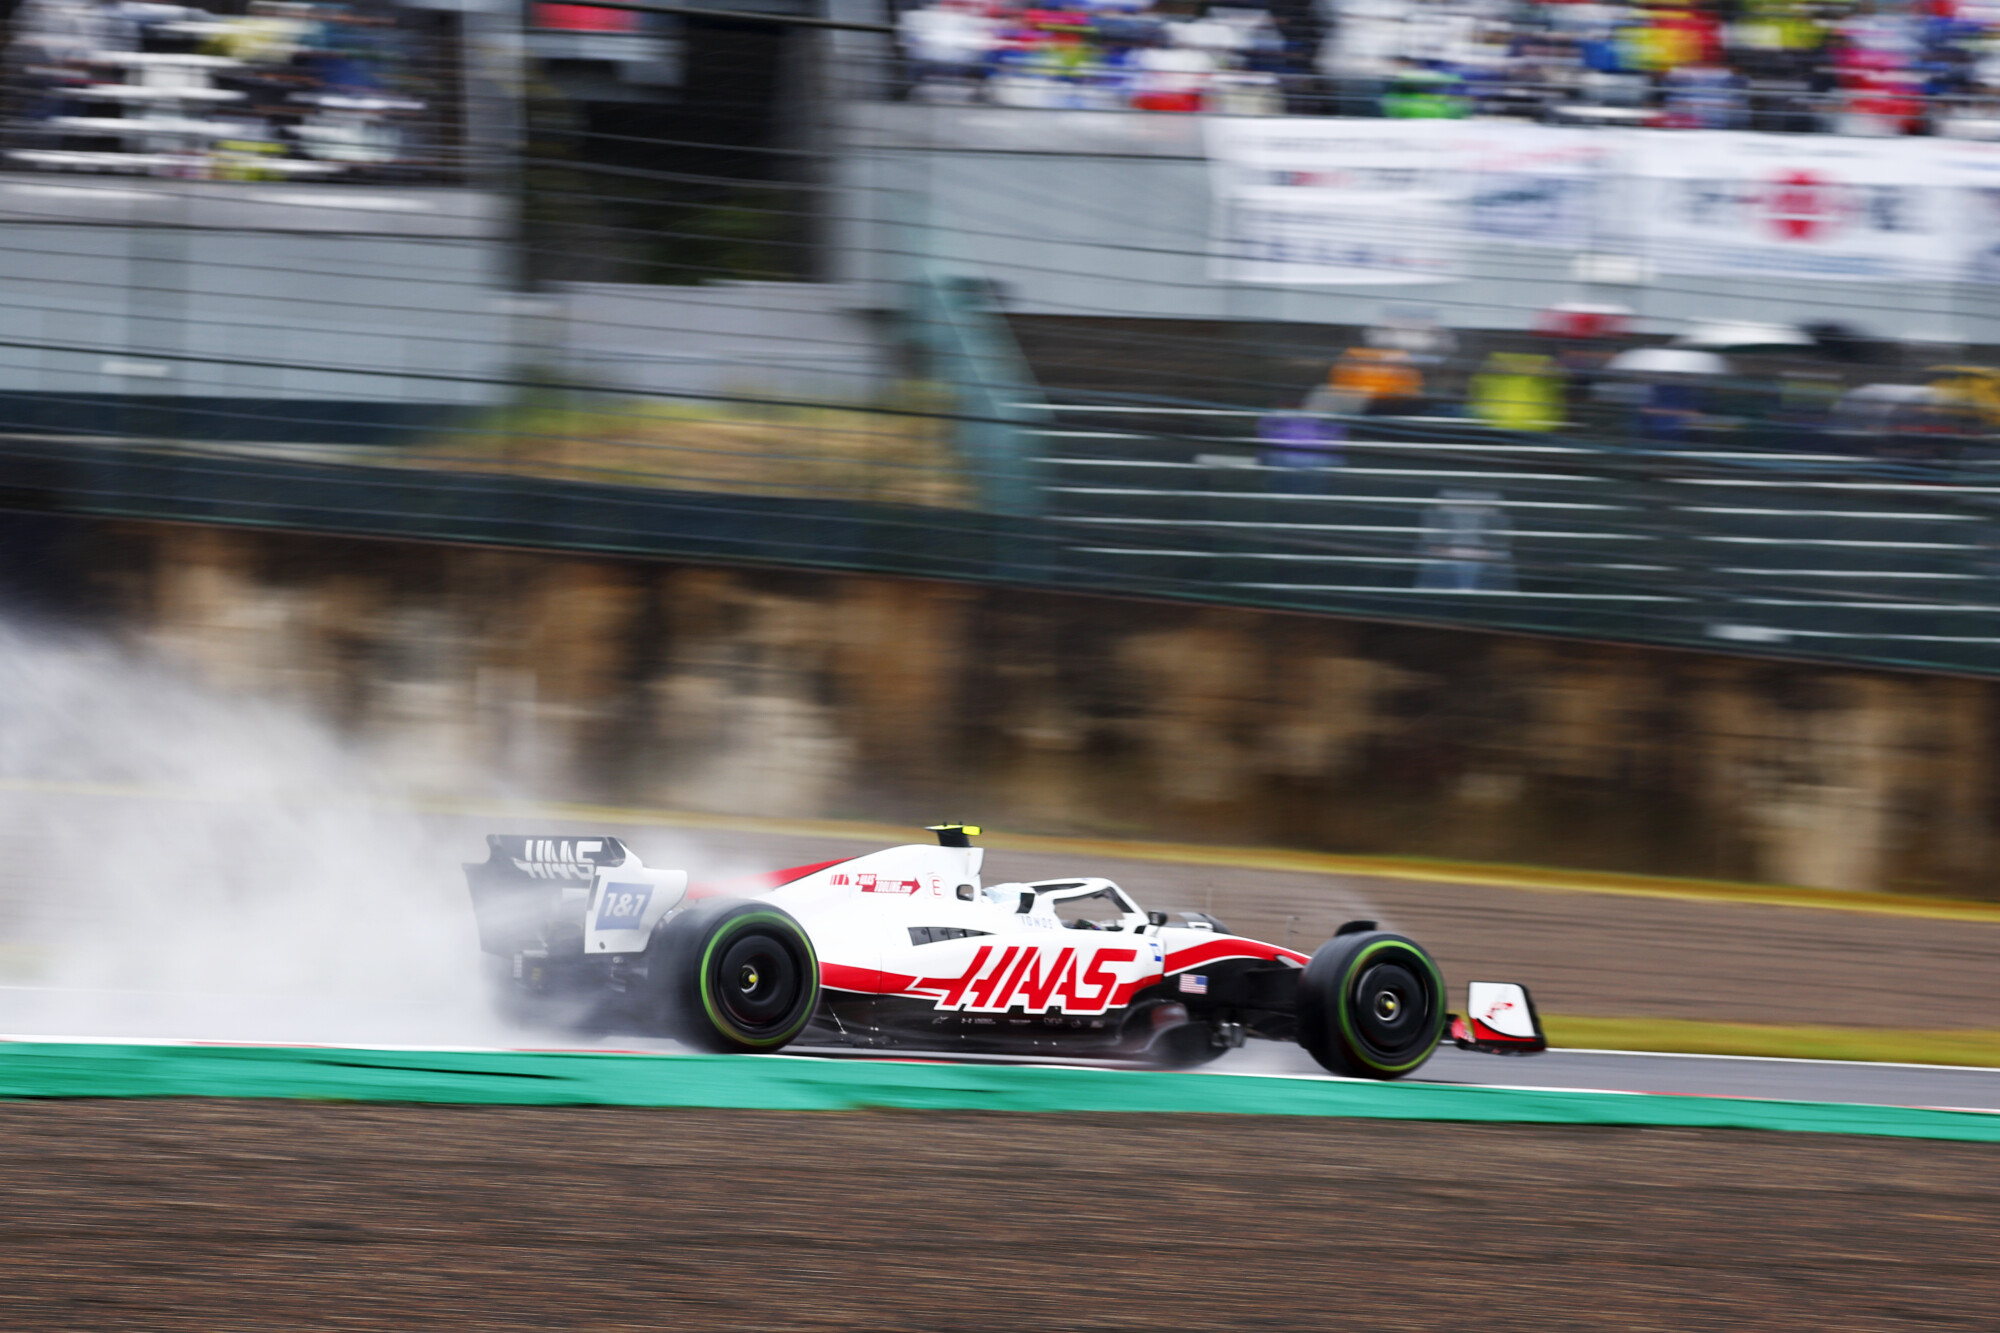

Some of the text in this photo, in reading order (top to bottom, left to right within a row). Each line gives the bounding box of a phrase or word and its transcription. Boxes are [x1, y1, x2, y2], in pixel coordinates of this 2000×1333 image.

[513, 839, 602, 880] HAAS
[605, 893, 646, 916] 1&1
[914, 945, 1137, 1011] HAAS
